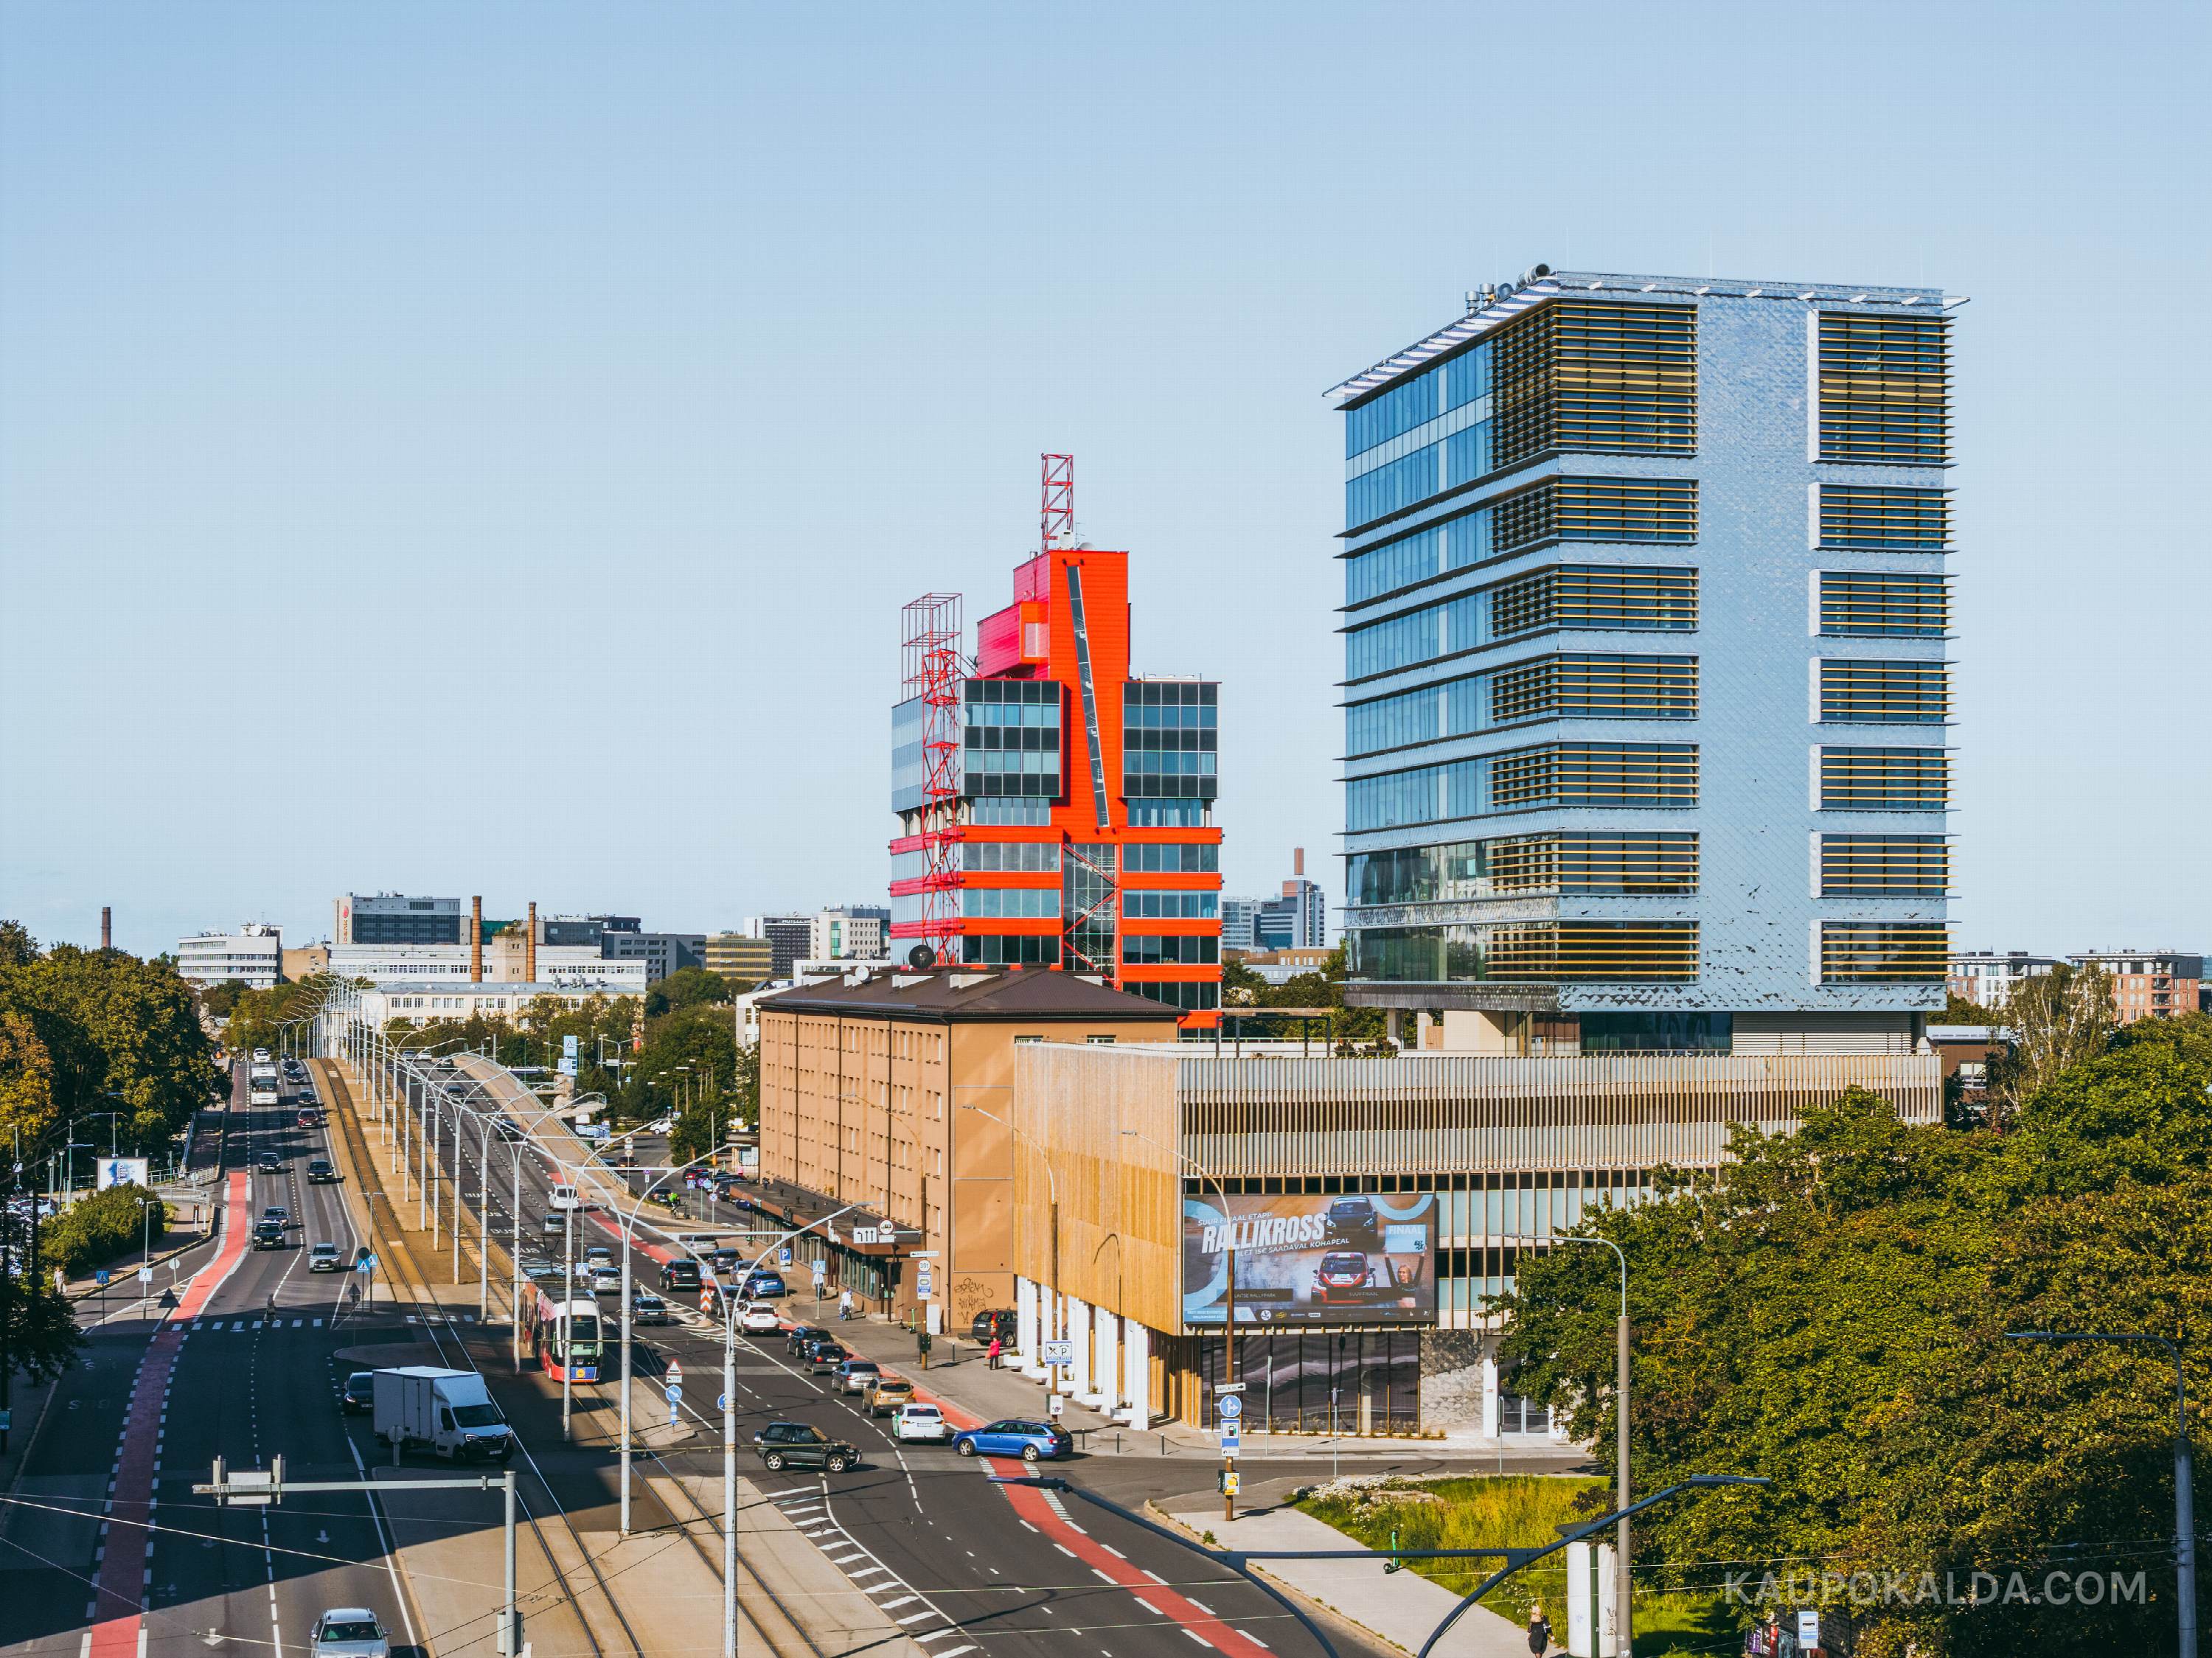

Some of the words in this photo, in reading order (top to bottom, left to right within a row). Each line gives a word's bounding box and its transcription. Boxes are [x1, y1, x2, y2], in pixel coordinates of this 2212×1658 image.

[1197, 1218, 1218, 1227] SUUR
[1220, 1214, 1247, 1224] FIAAL
[1248, 1211, 1272, 1220] ETAPP
[1201, 1213, 1327, 1253] RALLIKROSS
[1388, 1226, 1422, 1234] FINAAL
[1268, 1243, 1309, 1253] SAADAVAL
[1310, 1238, 1350, 1248] KOHAPEAL
